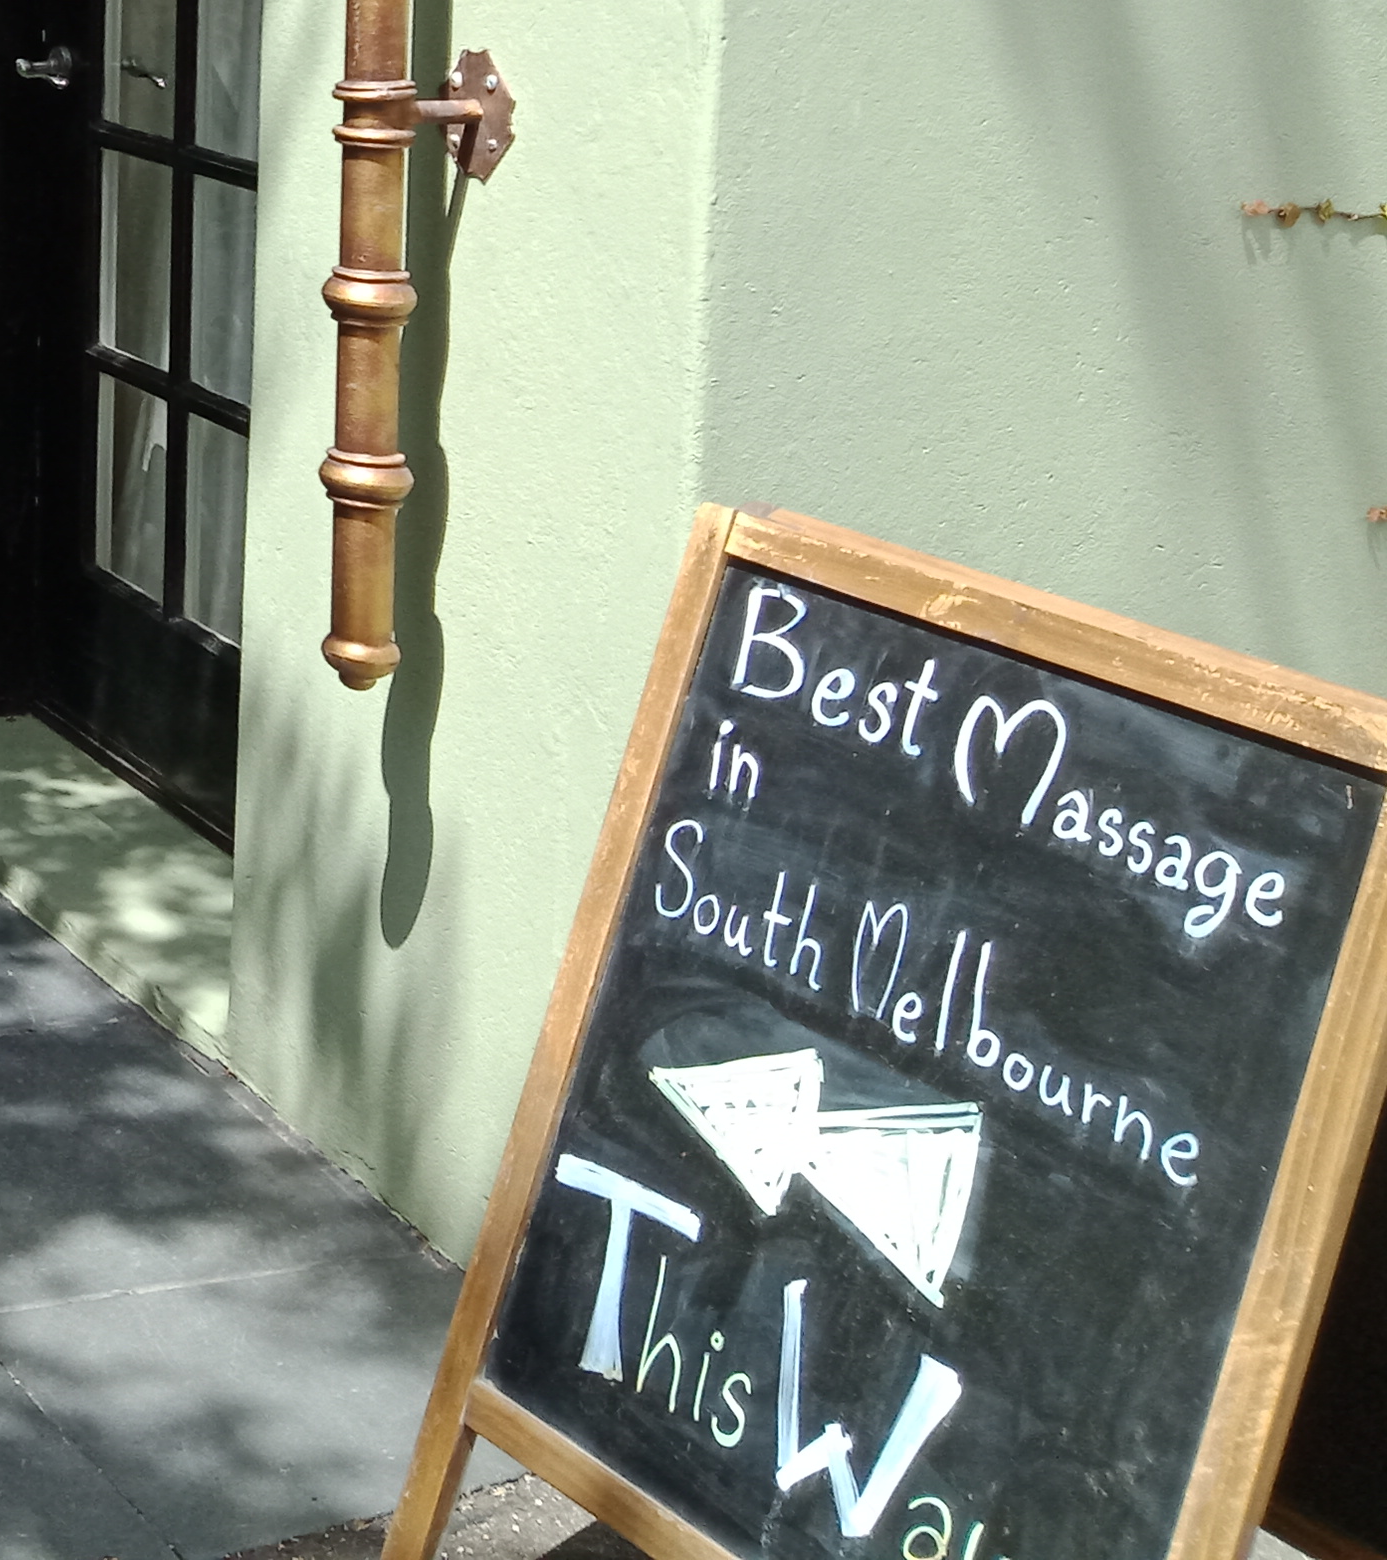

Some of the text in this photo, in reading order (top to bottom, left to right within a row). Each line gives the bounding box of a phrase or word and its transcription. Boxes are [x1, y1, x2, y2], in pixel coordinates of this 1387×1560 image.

[707, 719, 761, 801] in
[730, 585, 1286, 939] Best Massage
[655, 818, 1201, 1187] South Melbourne
[555, 1152, 1012, 1560] This Wa
